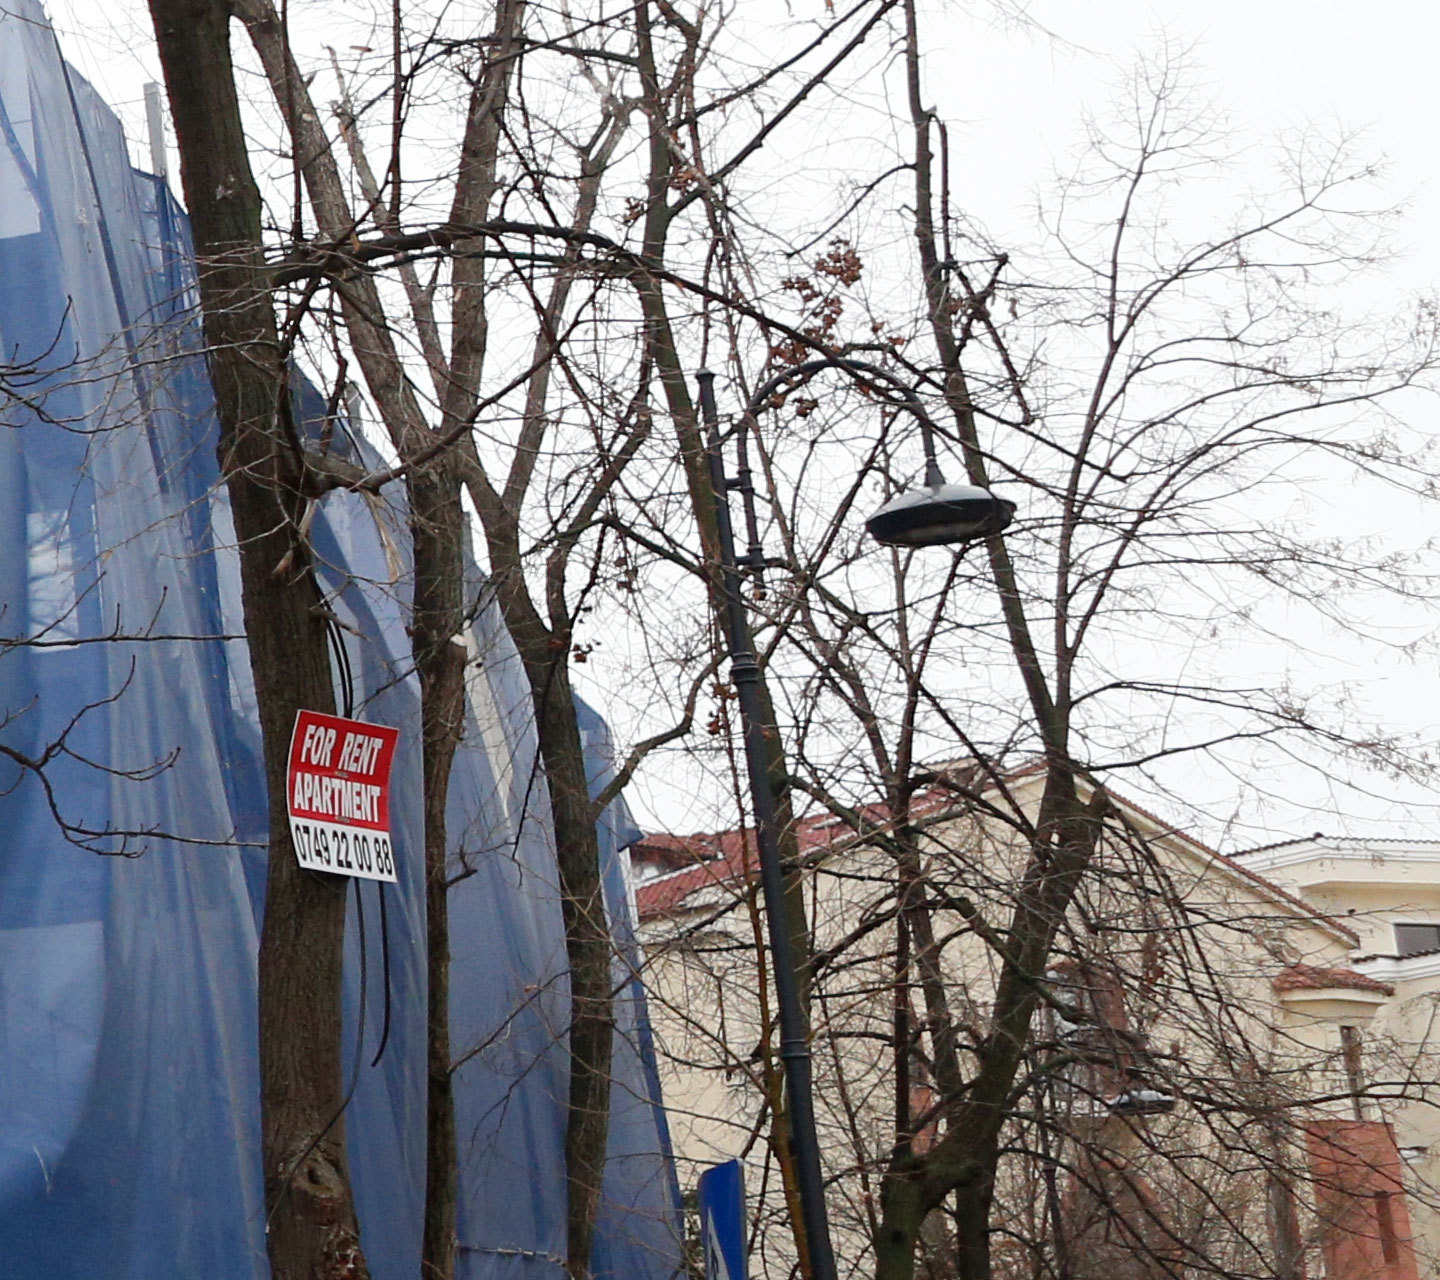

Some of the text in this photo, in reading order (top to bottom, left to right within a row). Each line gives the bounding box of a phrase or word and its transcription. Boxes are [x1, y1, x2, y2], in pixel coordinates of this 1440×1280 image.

[301, 724, 384, 776] FOR RENT
[294, 771, 382, 823] APARTMENT
[294, 824, 393, 876] 0749 22 00 88
